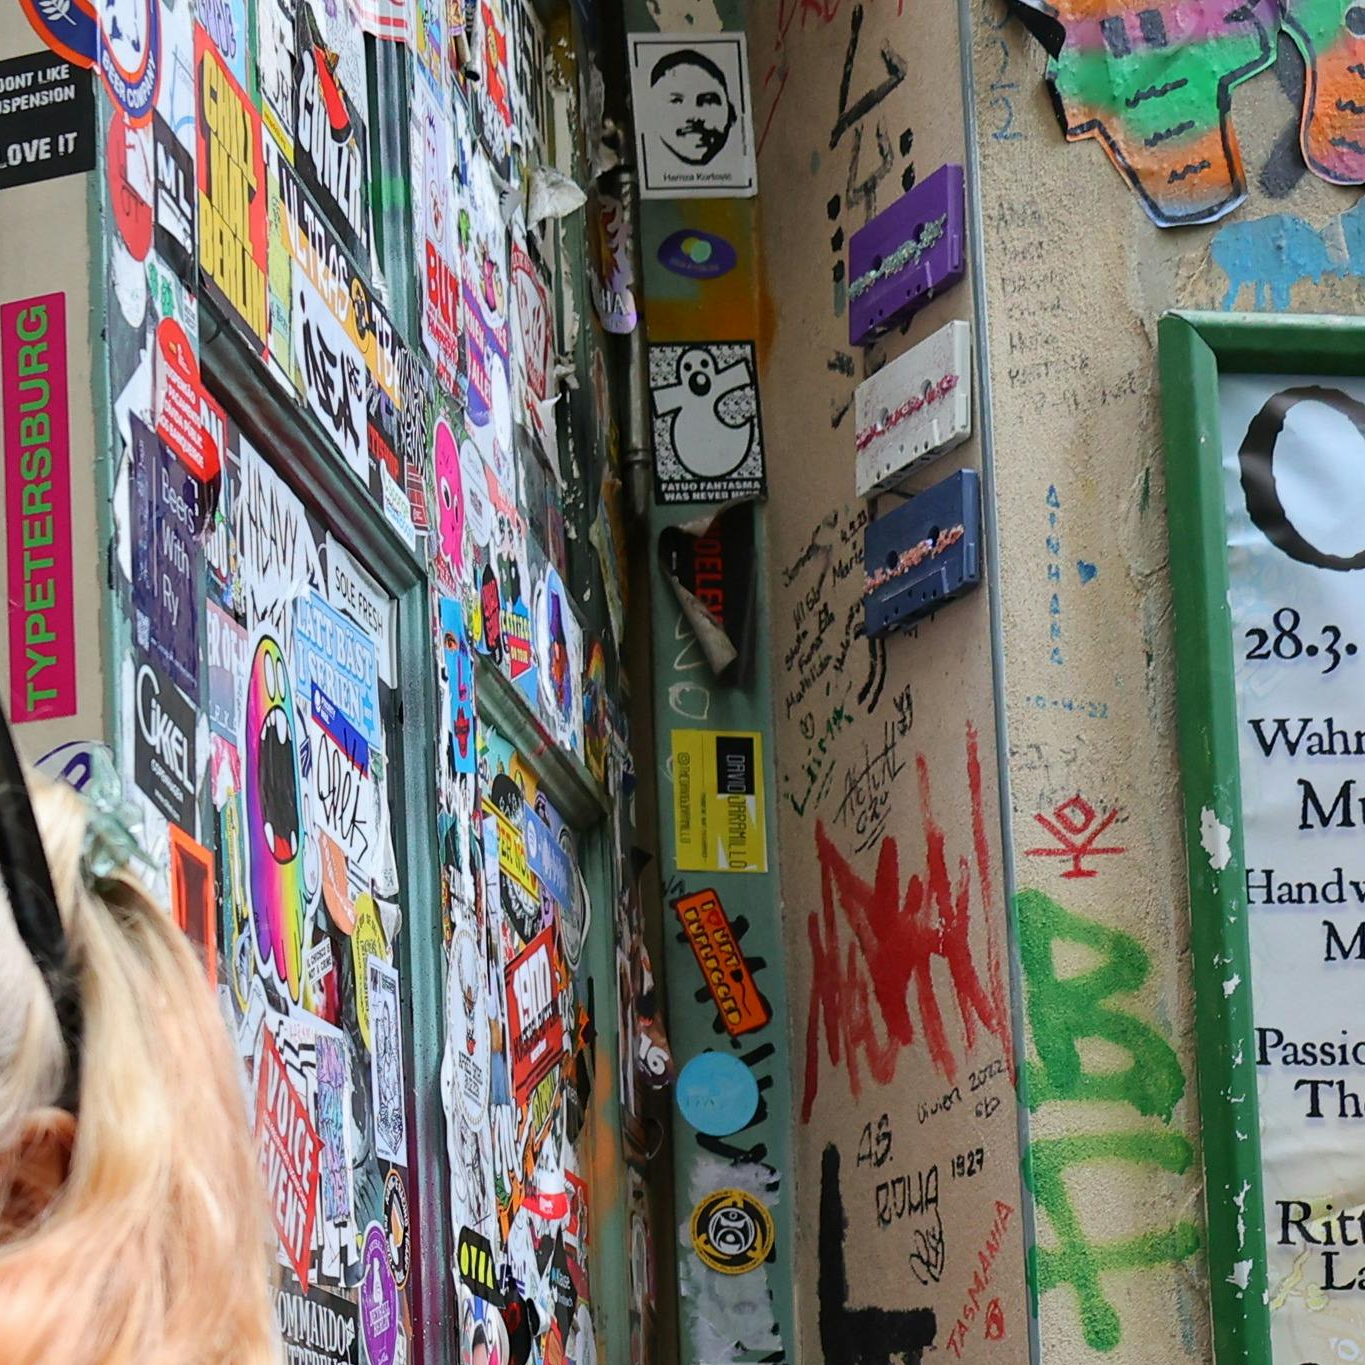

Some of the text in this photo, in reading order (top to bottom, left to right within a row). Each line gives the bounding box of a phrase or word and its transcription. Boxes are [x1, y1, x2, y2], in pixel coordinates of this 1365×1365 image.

[37, 63, 70, 85] LIKE
[102, 48, 157, 109] BEER COMPANY
[57, 131, 78, 156] IT
[198, 188, 268, 357] BERLIN
[281, 166, 350, 323] ULTRAS
[15, 303, 62, 712] TYPETERSBURG
[161, 467, 195, 534] Beers
[661, 479, 762, 493] FATUO FANTASMA
[162, 527, 191, 580] With
[334, 566, 384, 640] SOLE FRESH
[334, 622, 375, 690] BÄST
[1244, 606, 1358, 675] 28.3.
[308, 650, 363, 727] SERIEN
[726, 753, 749, 870] DAVID JARAMILLO
[268, 1049, 318, 1195] VOICE
[258, 1135, 310, 1264] EVENT
[946, 1200, 1015, 1360] TASMANIA
